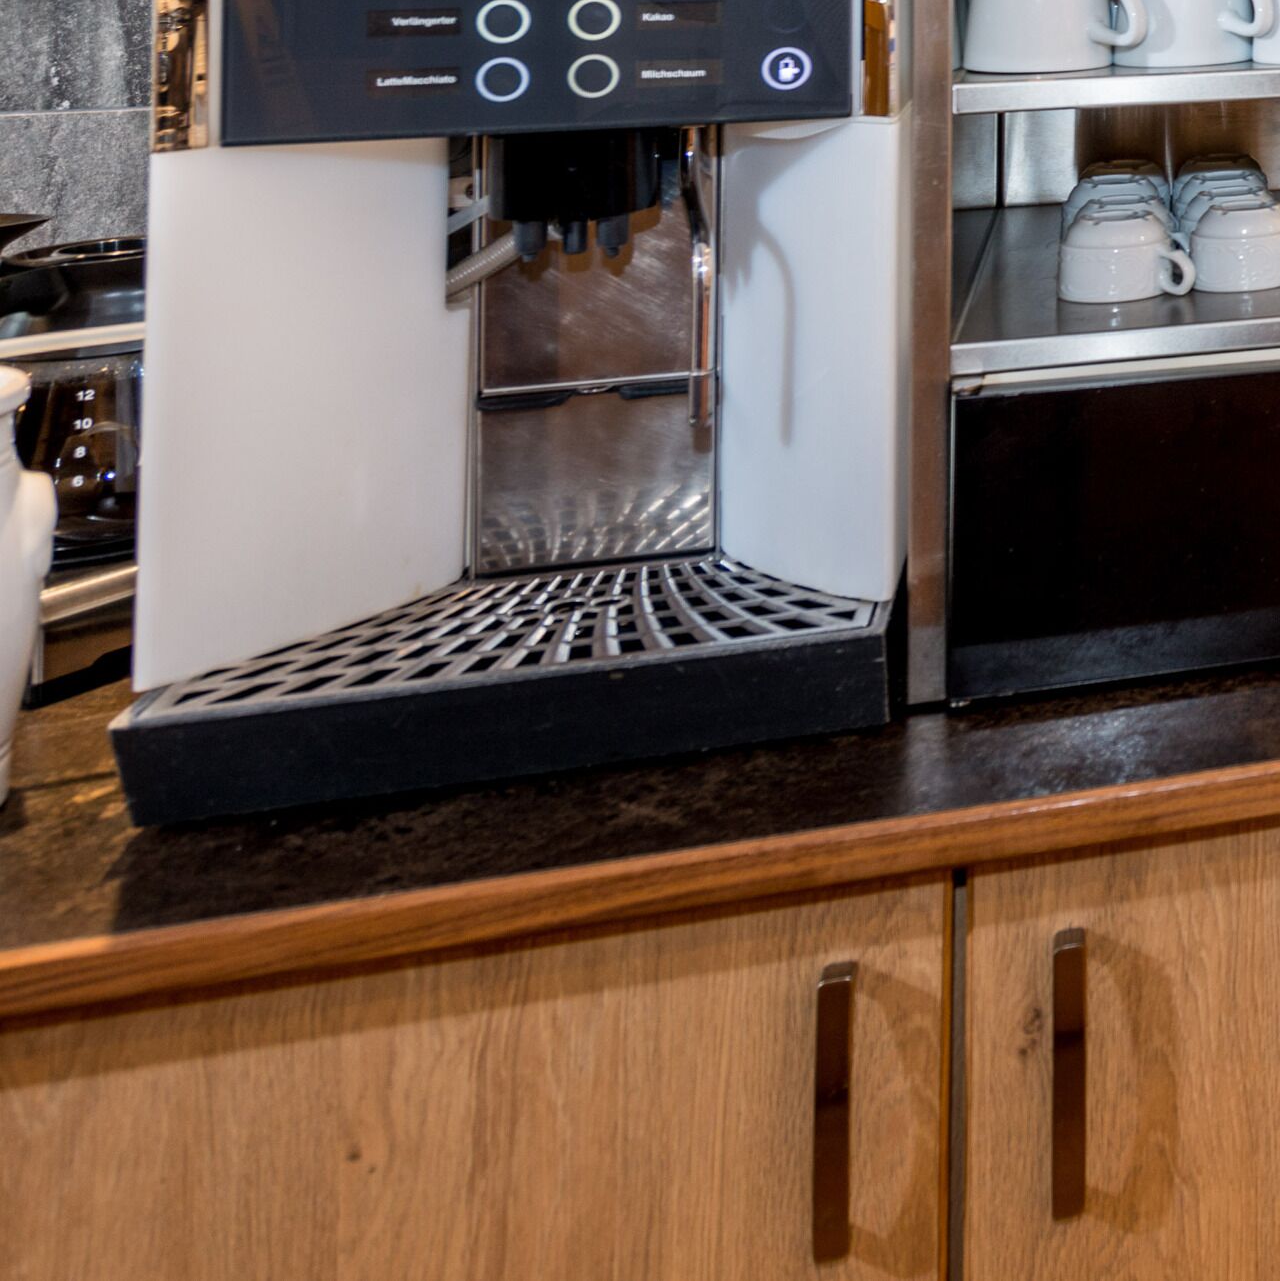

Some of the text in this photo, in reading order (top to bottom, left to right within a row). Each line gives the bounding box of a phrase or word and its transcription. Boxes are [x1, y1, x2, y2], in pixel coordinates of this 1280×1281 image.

[641, 12, 675, 22] Kakao
[641, 69, 707, 80] Milchschaum
[75, 389, 95, 401] 12
[73, 418, 93, 430] 10
[73, 446, 86, 458] 8
[72, 475, 84, 487] 6
